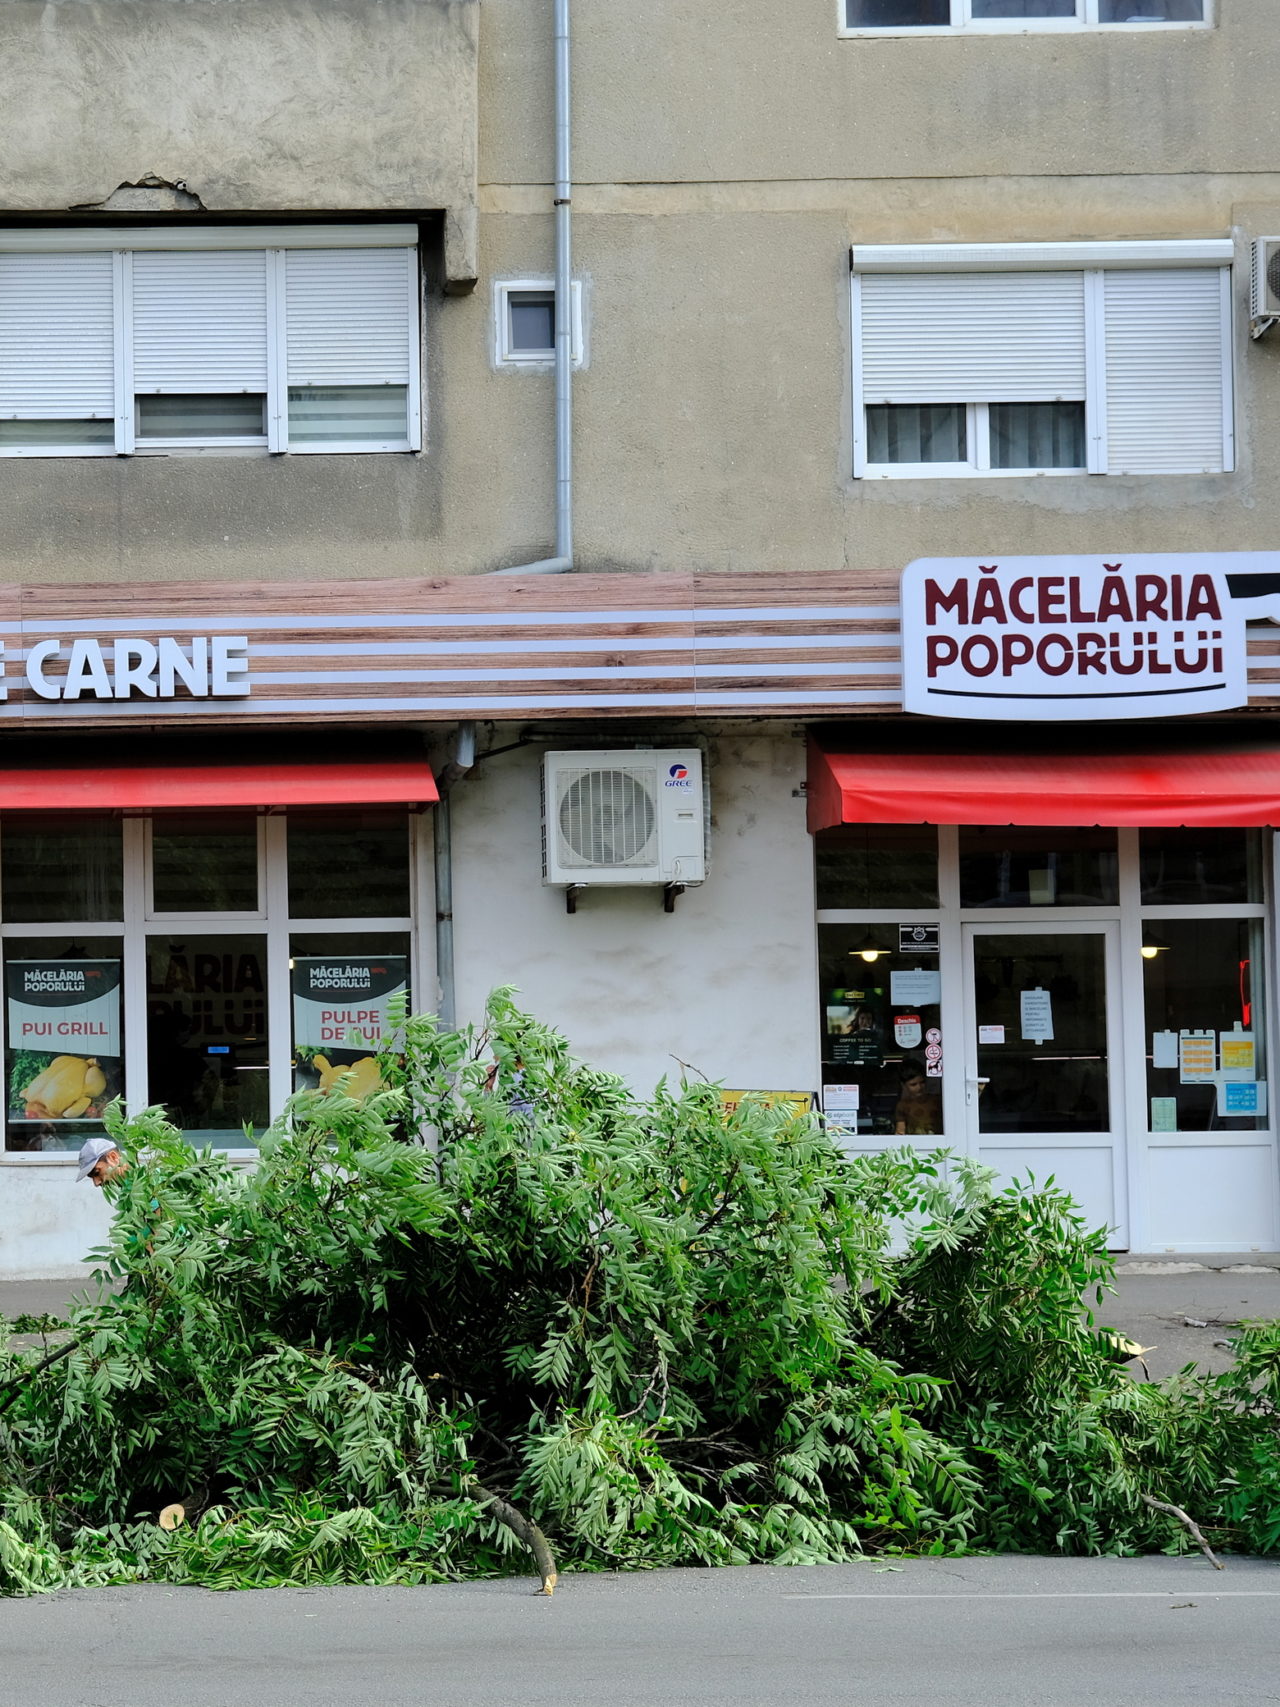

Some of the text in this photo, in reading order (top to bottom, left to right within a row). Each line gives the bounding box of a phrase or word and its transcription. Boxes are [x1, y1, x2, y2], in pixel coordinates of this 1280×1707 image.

[924, 563, 1222, 625] MĂCELĂRIA
[926, 630, 1223, 678] POPORULUI
[25, 636, 251, 699] CARNE
[24, 969, 85, 981] MĂCELĂRIA
[310, 966, 370, 978] MĂCELĂRIA
[24, 982, 85, 991] POPORULUI
[310, 978, 370, 988] POPORULUI
[321, 1010, 380, 1024] PULPE
[22, 1022, 108, 1036] PUI GRILL
[321, 1027, 381, 1040] DE UI
